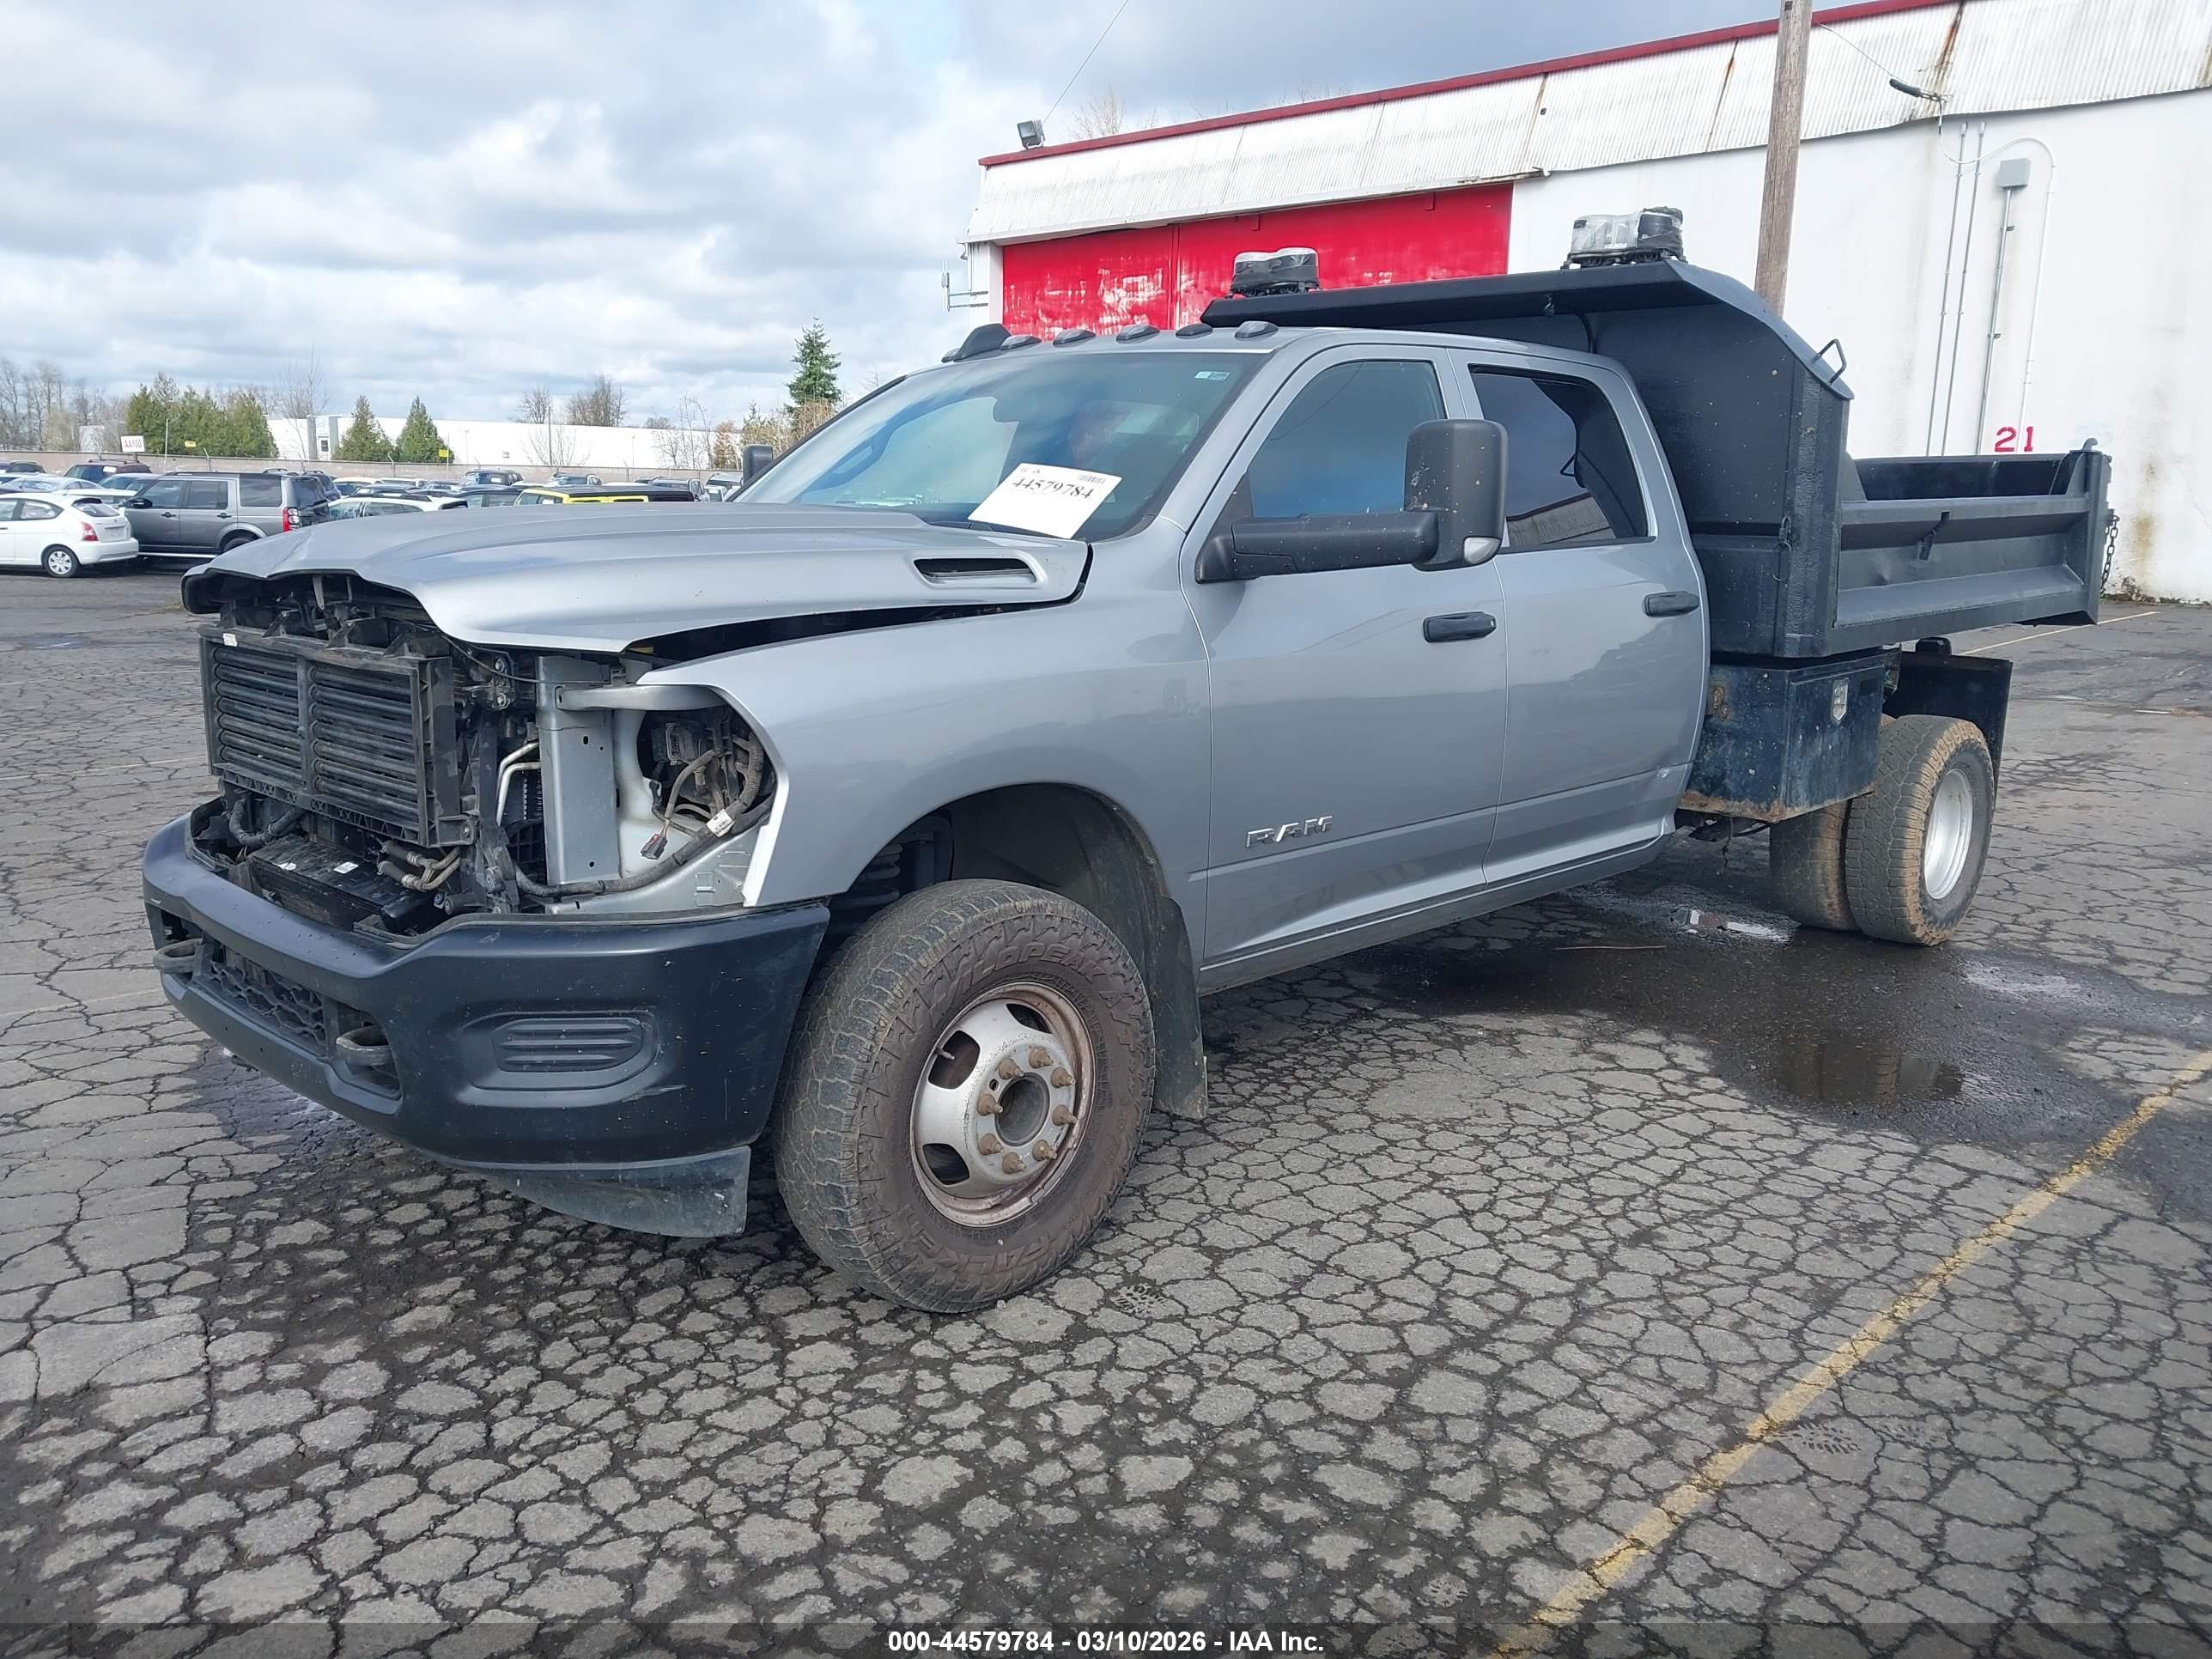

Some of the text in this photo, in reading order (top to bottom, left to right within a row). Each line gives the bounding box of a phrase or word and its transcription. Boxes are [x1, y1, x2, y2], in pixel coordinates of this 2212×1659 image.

[1994, 426, 2034, 453] 21
[1012, 477, 1095, 499] 44579784
[1245, 815, 1334, 848] RAM
